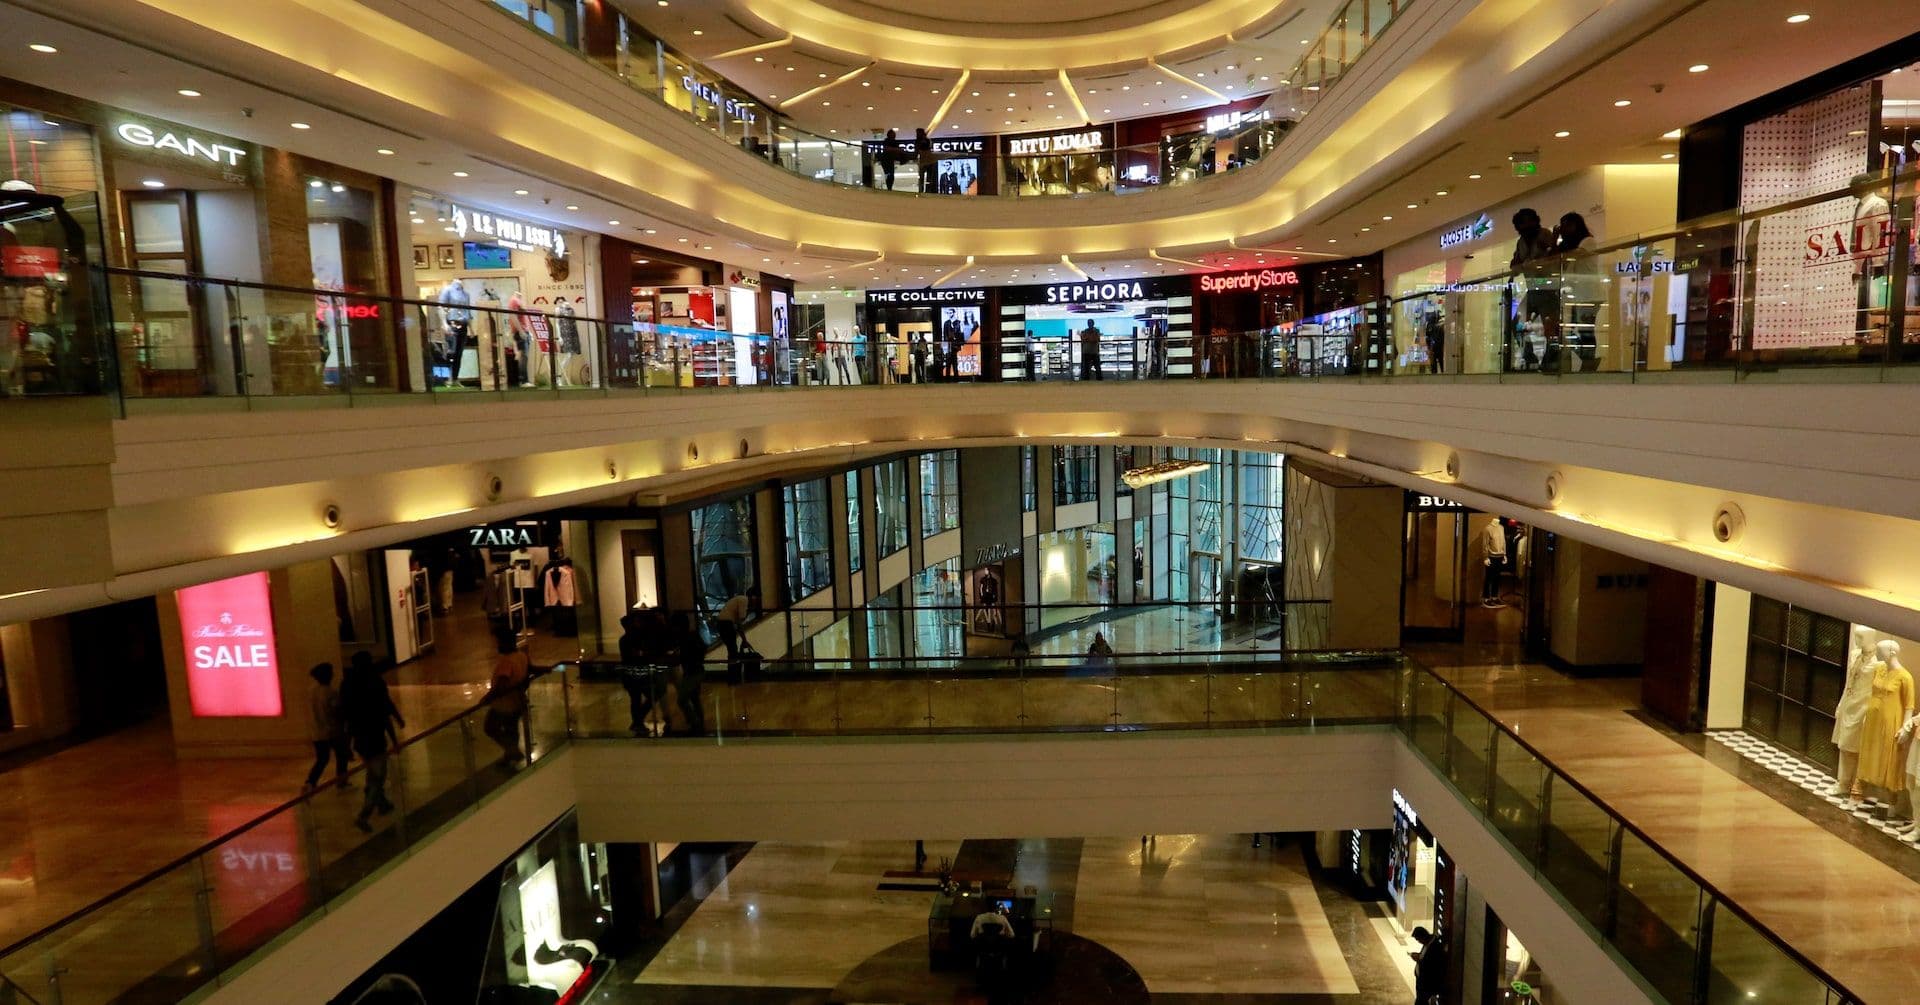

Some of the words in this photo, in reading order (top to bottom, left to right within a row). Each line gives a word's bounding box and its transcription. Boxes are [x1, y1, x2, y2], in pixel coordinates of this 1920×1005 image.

[118, 123, 246, 166] GANT
[1010, 137, 1050, 154] RITU
[1052, 131, 1103, 151] KUMAR
[495, 218, 523, 241] POLO
[1440, 226, 1470, 248] LACOSTE
[869, 292, 897, 301] THE
[901, 290, 986, 301] COLLECTIVE
[1047, 282, 1143, 302] SEPHORA
[470, 528, 532, 545] ZARA
[194, 643, 270, 669] SALE
